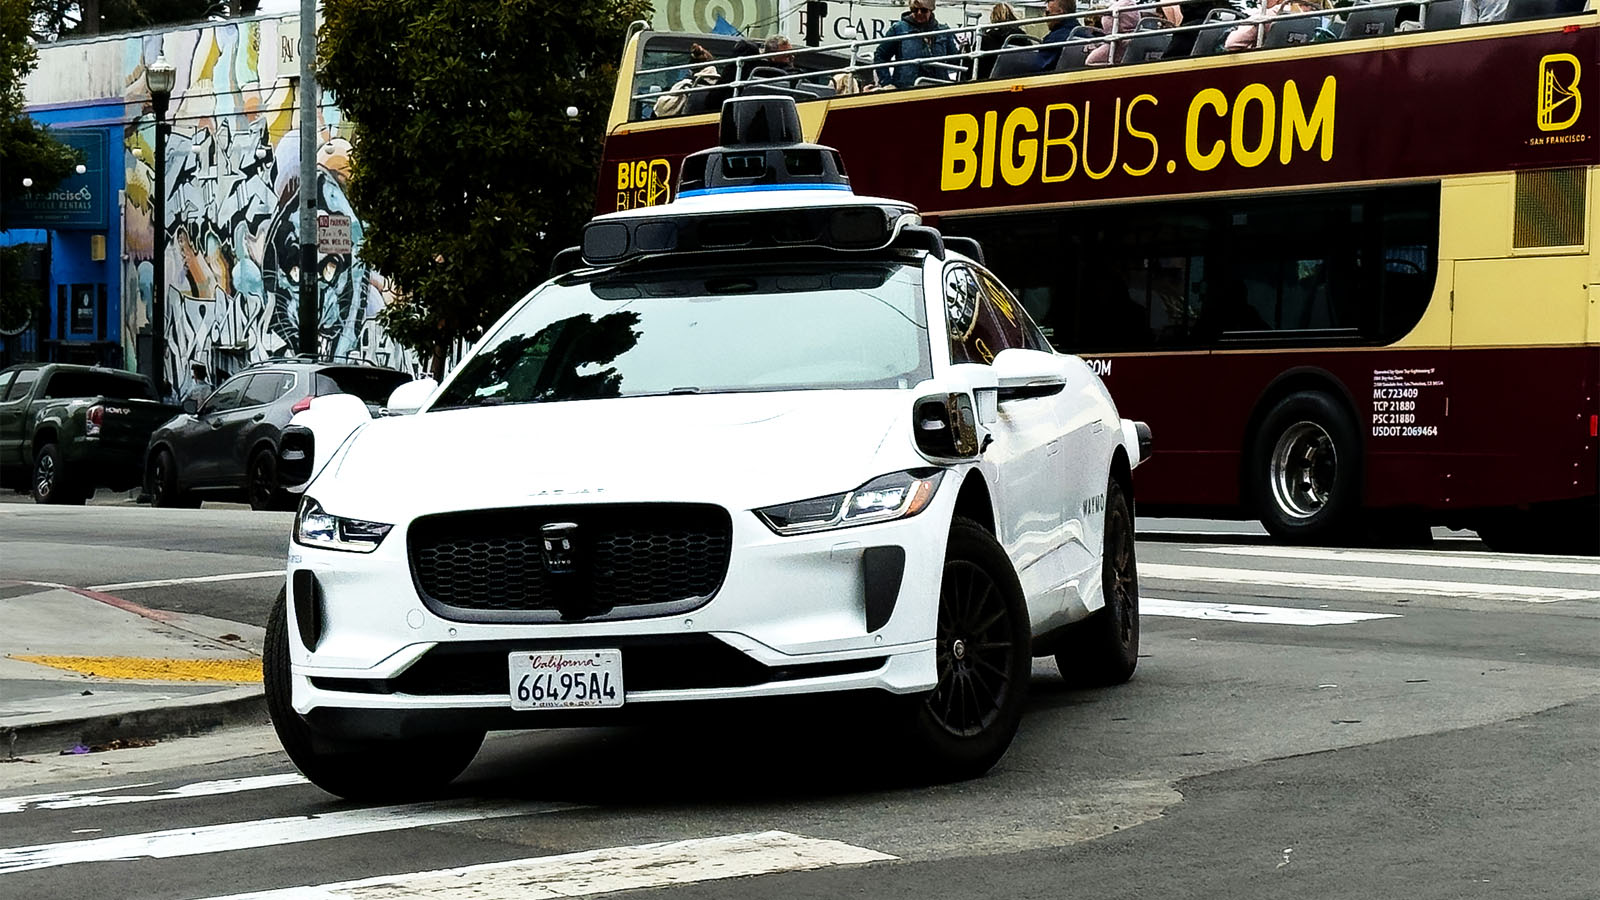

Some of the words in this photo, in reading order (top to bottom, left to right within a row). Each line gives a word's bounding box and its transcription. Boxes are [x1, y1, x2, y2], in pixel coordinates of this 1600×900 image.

[940, 75, 1337, 191] BIGBUS.COM
[1529, 138, 1544, 146] SAN
[1546, 134, 1586, 144] FRANCISCO
[617, 160, 648, 190] BIG
[59, 201, 92, 209] RENTALS
[1373, 388, 1387, 399] MC
[1388, 388, 1419, 399] 723409
[1373, 401, 1389, 411] TCP
[1389, 401, 1416, 411] 21880
[1372, 414, 1389, 424] PSC
[1389, 414, 1416, 424] 21880
[1372, 426, 1401, 436] USDOT
[1402, 426, 1438, 436] 2069464
[532, 654, 601, 672] California
[517, 672, 616, 701] 66495A4
